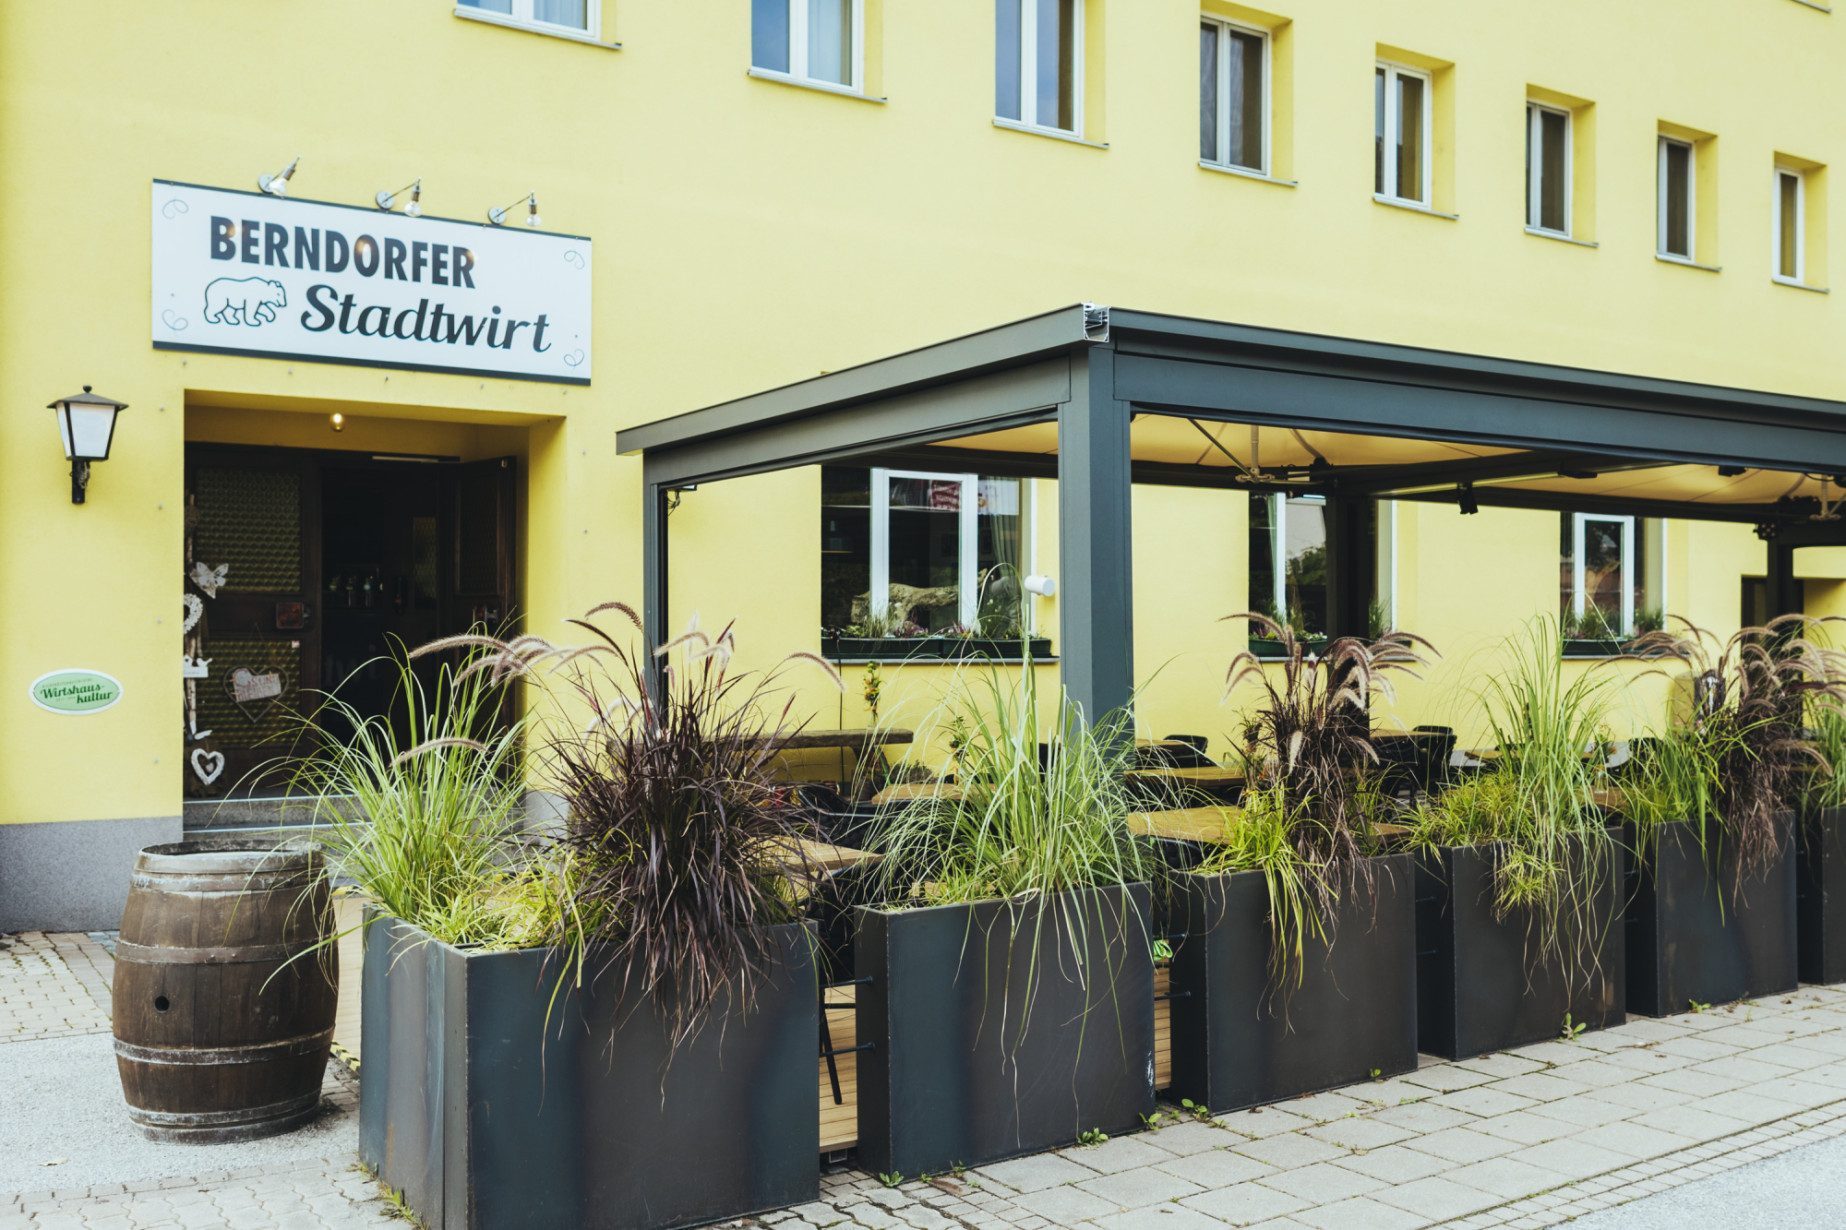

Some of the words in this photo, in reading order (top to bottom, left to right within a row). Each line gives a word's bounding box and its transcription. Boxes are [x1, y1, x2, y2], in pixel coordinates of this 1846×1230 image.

[210, 215, 476, 289] BERNDORFER
[300, 283, 553, 353] Stadtwirt
[76, 691, 113, 704] kultur
